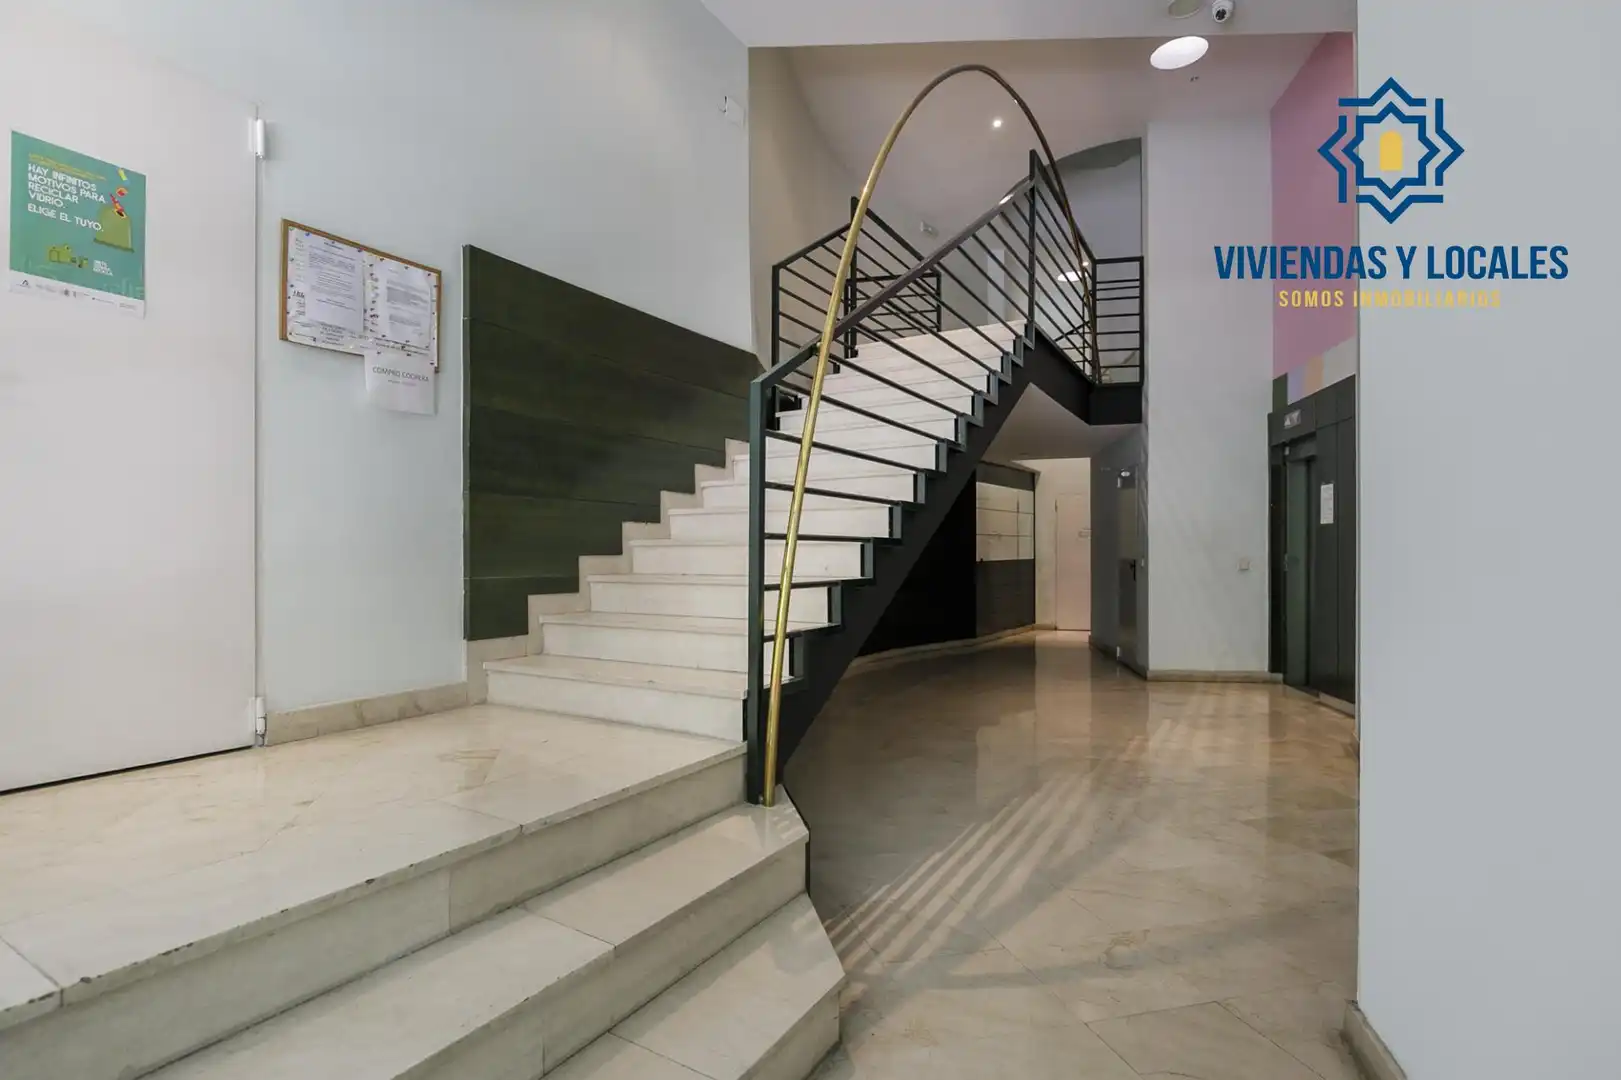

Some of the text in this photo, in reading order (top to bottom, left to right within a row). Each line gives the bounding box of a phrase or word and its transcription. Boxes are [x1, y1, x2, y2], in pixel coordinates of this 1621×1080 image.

[28, 163, 48, 177] HAY
[52, 170, 97, 191] INFINITOS
[28, 172, 106, 204] MOTIVOS PARA
[28, 181, 79, 204] RECICLAR
[28, 190, 66, 209] VIDRIO.
[27, 203, 104, 232] ELIGE EL TUYO.
